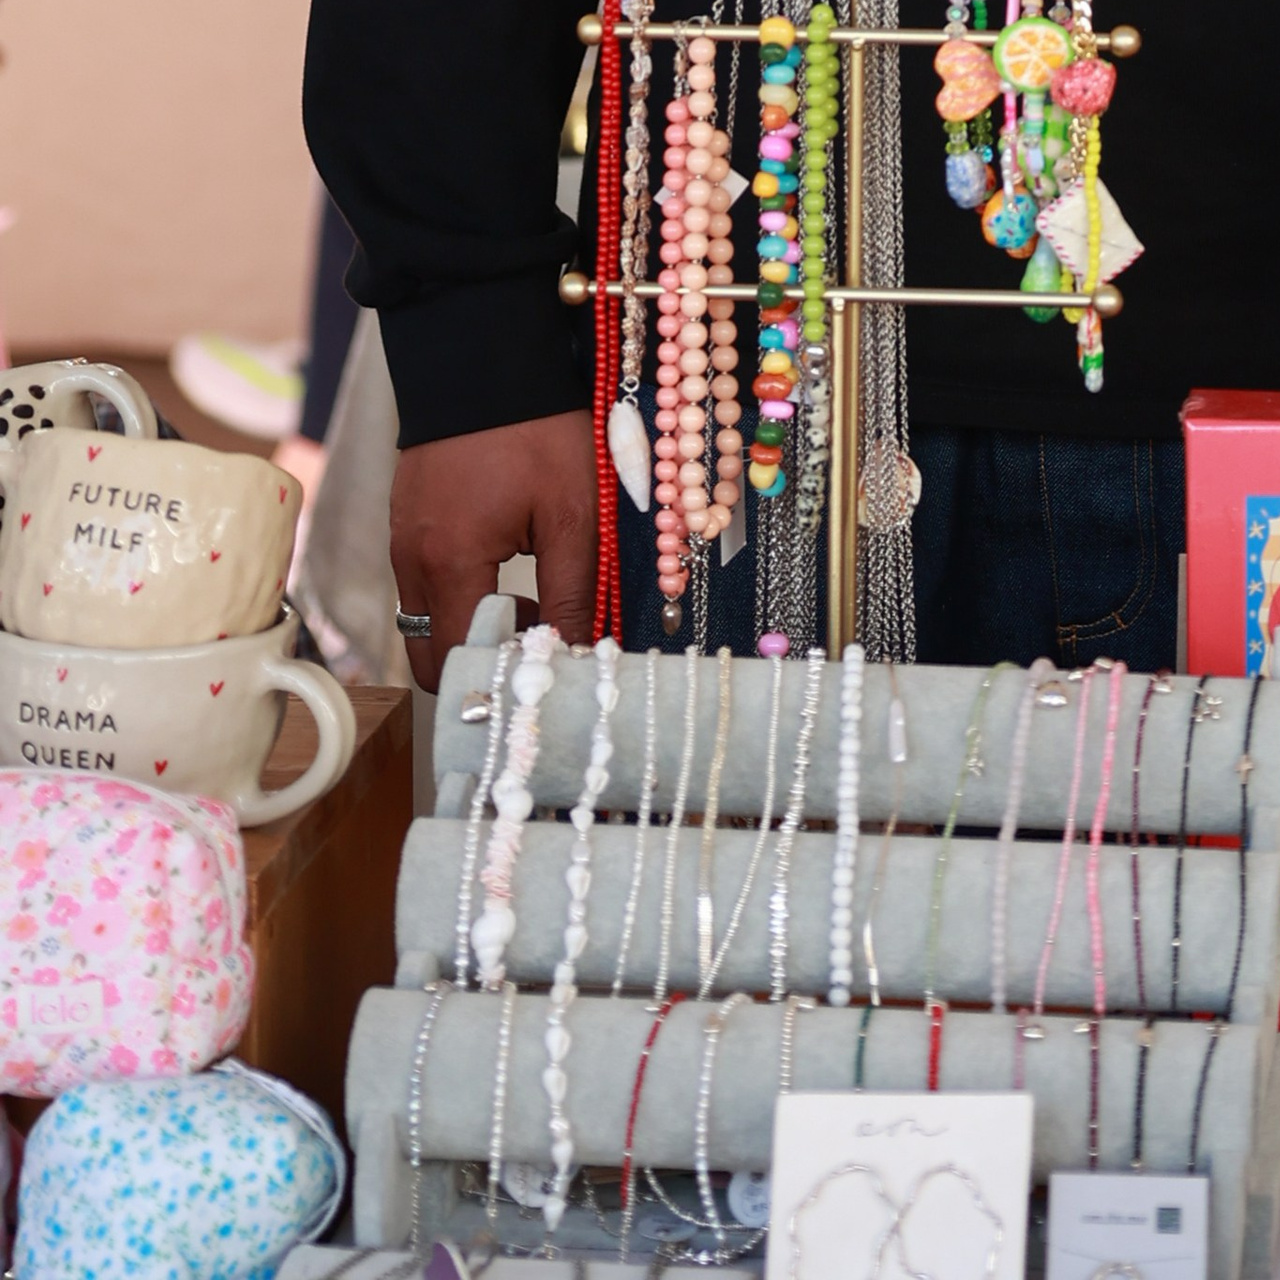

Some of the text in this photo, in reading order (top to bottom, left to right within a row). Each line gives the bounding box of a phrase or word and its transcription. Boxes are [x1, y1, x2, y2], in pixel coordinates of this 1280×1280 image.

[68, 482, 182, 522] FUTURE
[73, 522, 143, 553] MILF
[20, 701, 118, 733] DRAMA
[21, 741, 115, 771] QUEEN
